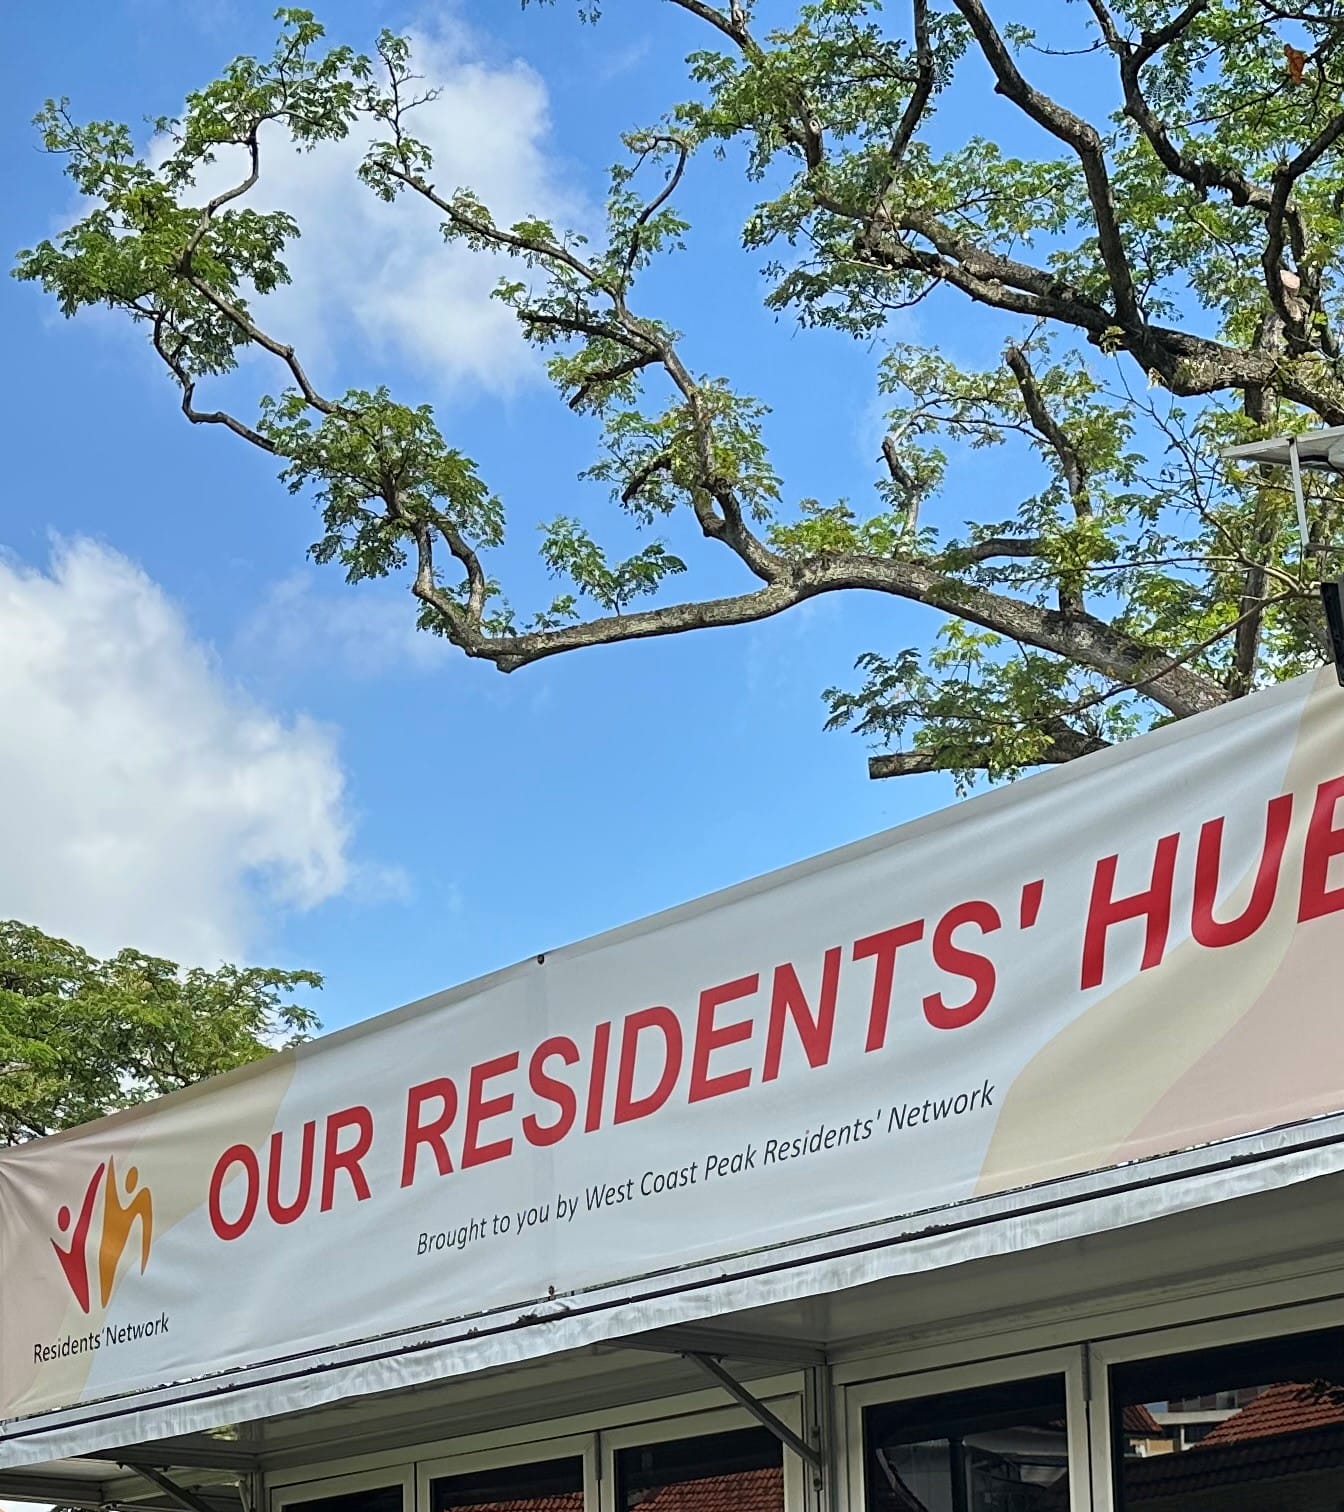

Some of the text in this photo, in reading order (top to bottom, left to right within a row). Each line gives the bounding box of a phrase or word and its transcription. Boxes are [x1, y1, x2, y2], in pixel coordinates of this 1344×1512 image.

[209, 1106, 373, 1240] OUR
[402, 881, 1043, 1186] RESIDENTS'
[417, 1079, 996, 1255] Brought to you by West Coast Peak Residents' Network
[105, 1311, 170, 1347] Network
